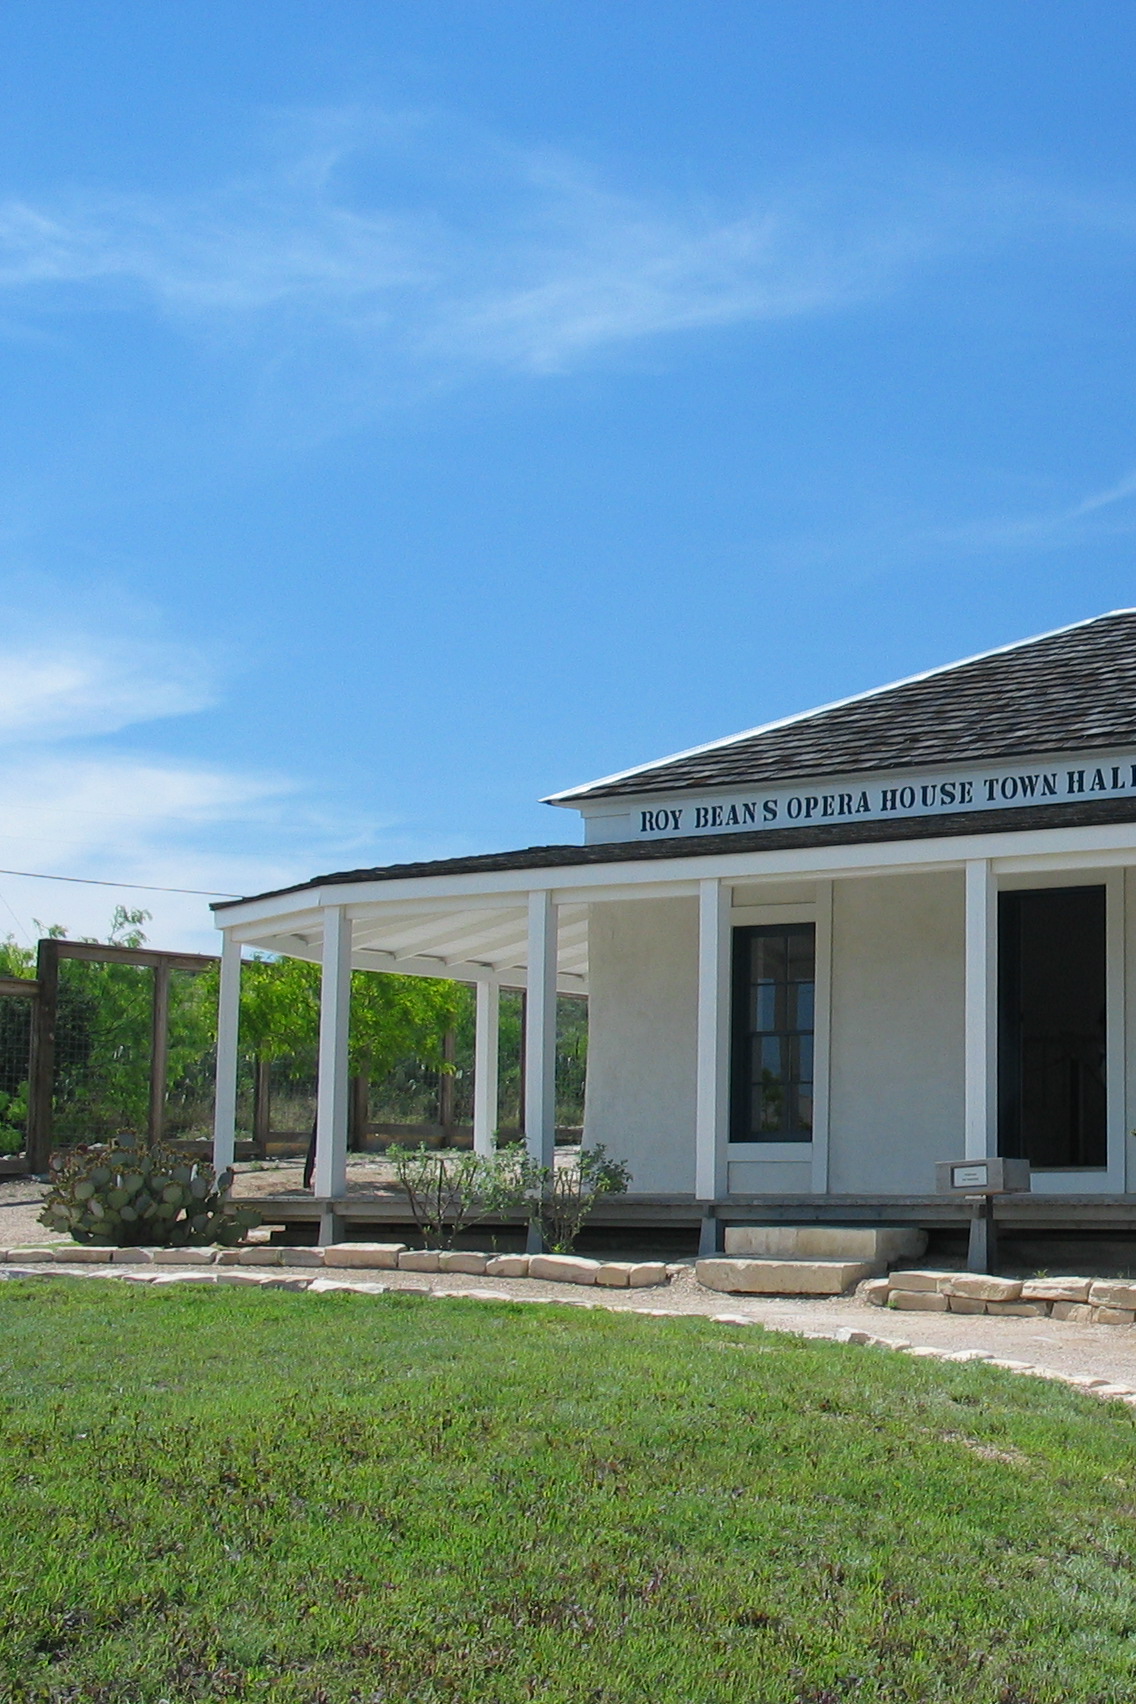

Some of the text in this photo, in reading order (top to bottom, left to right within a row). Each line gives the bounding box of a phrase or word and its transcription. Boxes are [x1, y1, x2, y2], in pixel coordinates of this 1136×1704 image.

[640, 807, 682, 832] ROY
[694, 800, 777, 828] BEANS
[786, 790, 870, 819] OPERA
[880, 781, 973, 811] HOUSE
[983, 773, 1057, 801] TOWN
